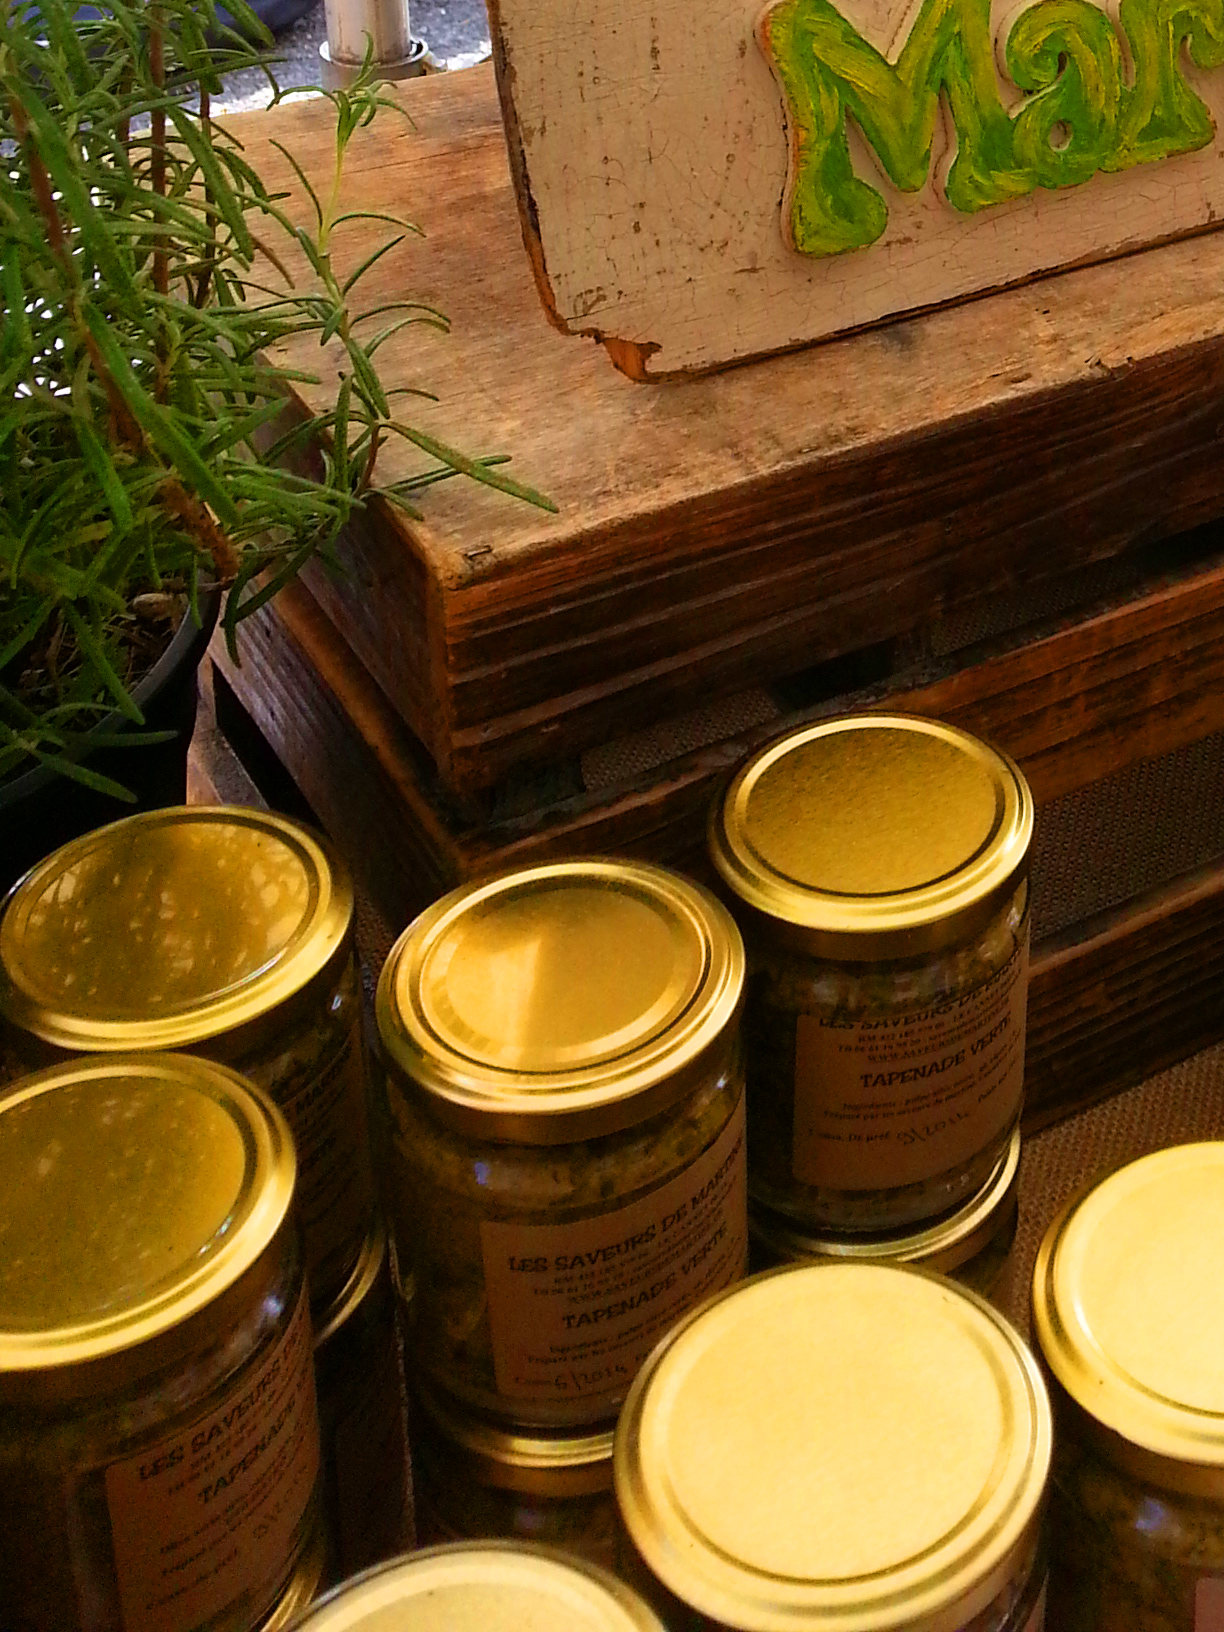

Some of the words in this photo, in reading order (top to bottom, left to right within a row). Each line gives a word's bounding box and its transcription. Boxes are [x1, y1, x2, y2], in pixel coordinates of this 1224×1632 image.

[859, 1048, 966, 1088] TAPENADE
[508, 1255, 549, 1273] LES
[553, 1223, 657, 1273] SAVEURS
[660, 1203, 689, 1235] DE
[561, 1271, 677, 1330] TAPENADE
[138, 1444, 186, 1482] LES
